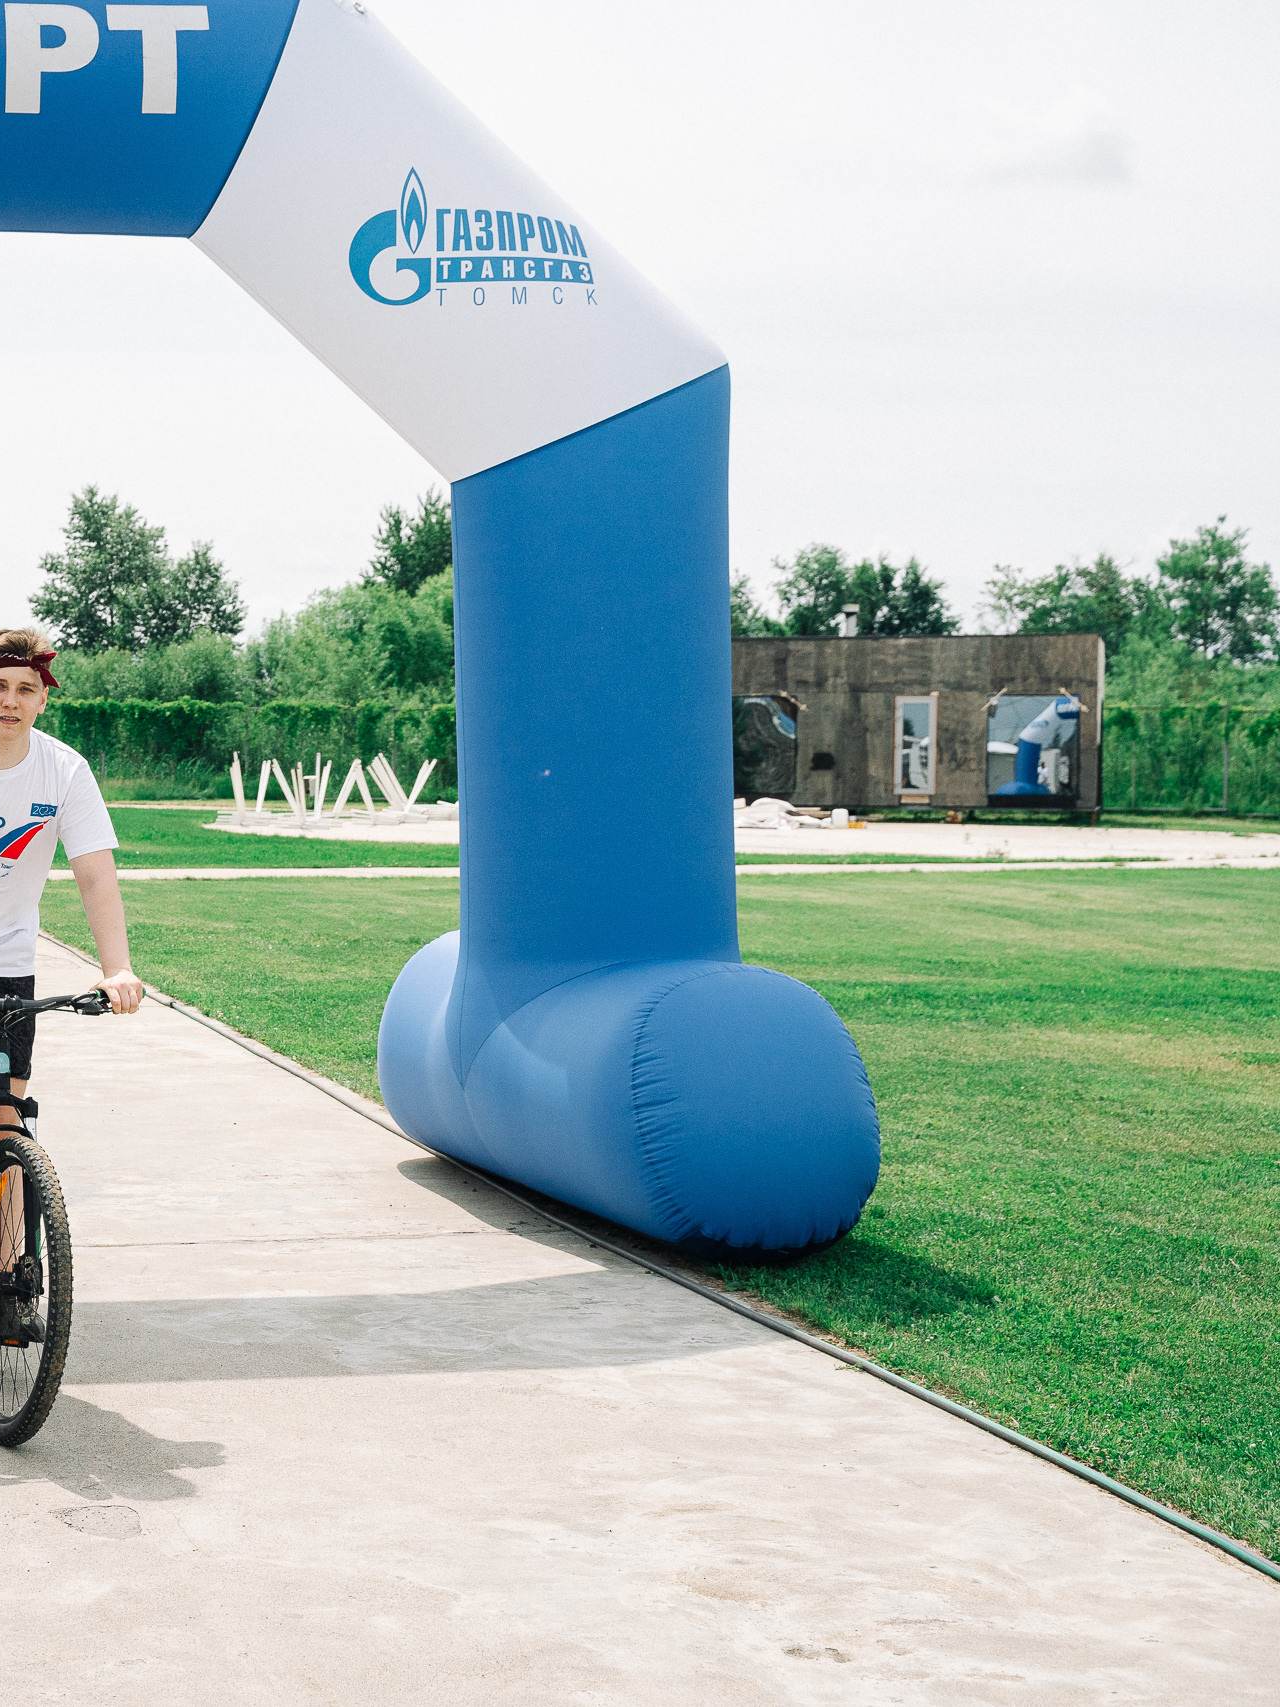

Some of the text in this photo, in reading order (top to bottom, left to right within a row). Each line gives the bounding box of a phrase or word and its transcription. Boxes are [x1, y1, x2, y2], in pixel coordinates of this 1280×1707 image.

[436, 208, 588, 258] ГАЗПРОМ
[439, 259, 591, 282] ТРАНСГАЗ
[436, 286, 598, 306] ТОМСК
[32, 805, 56, 816] 2022
